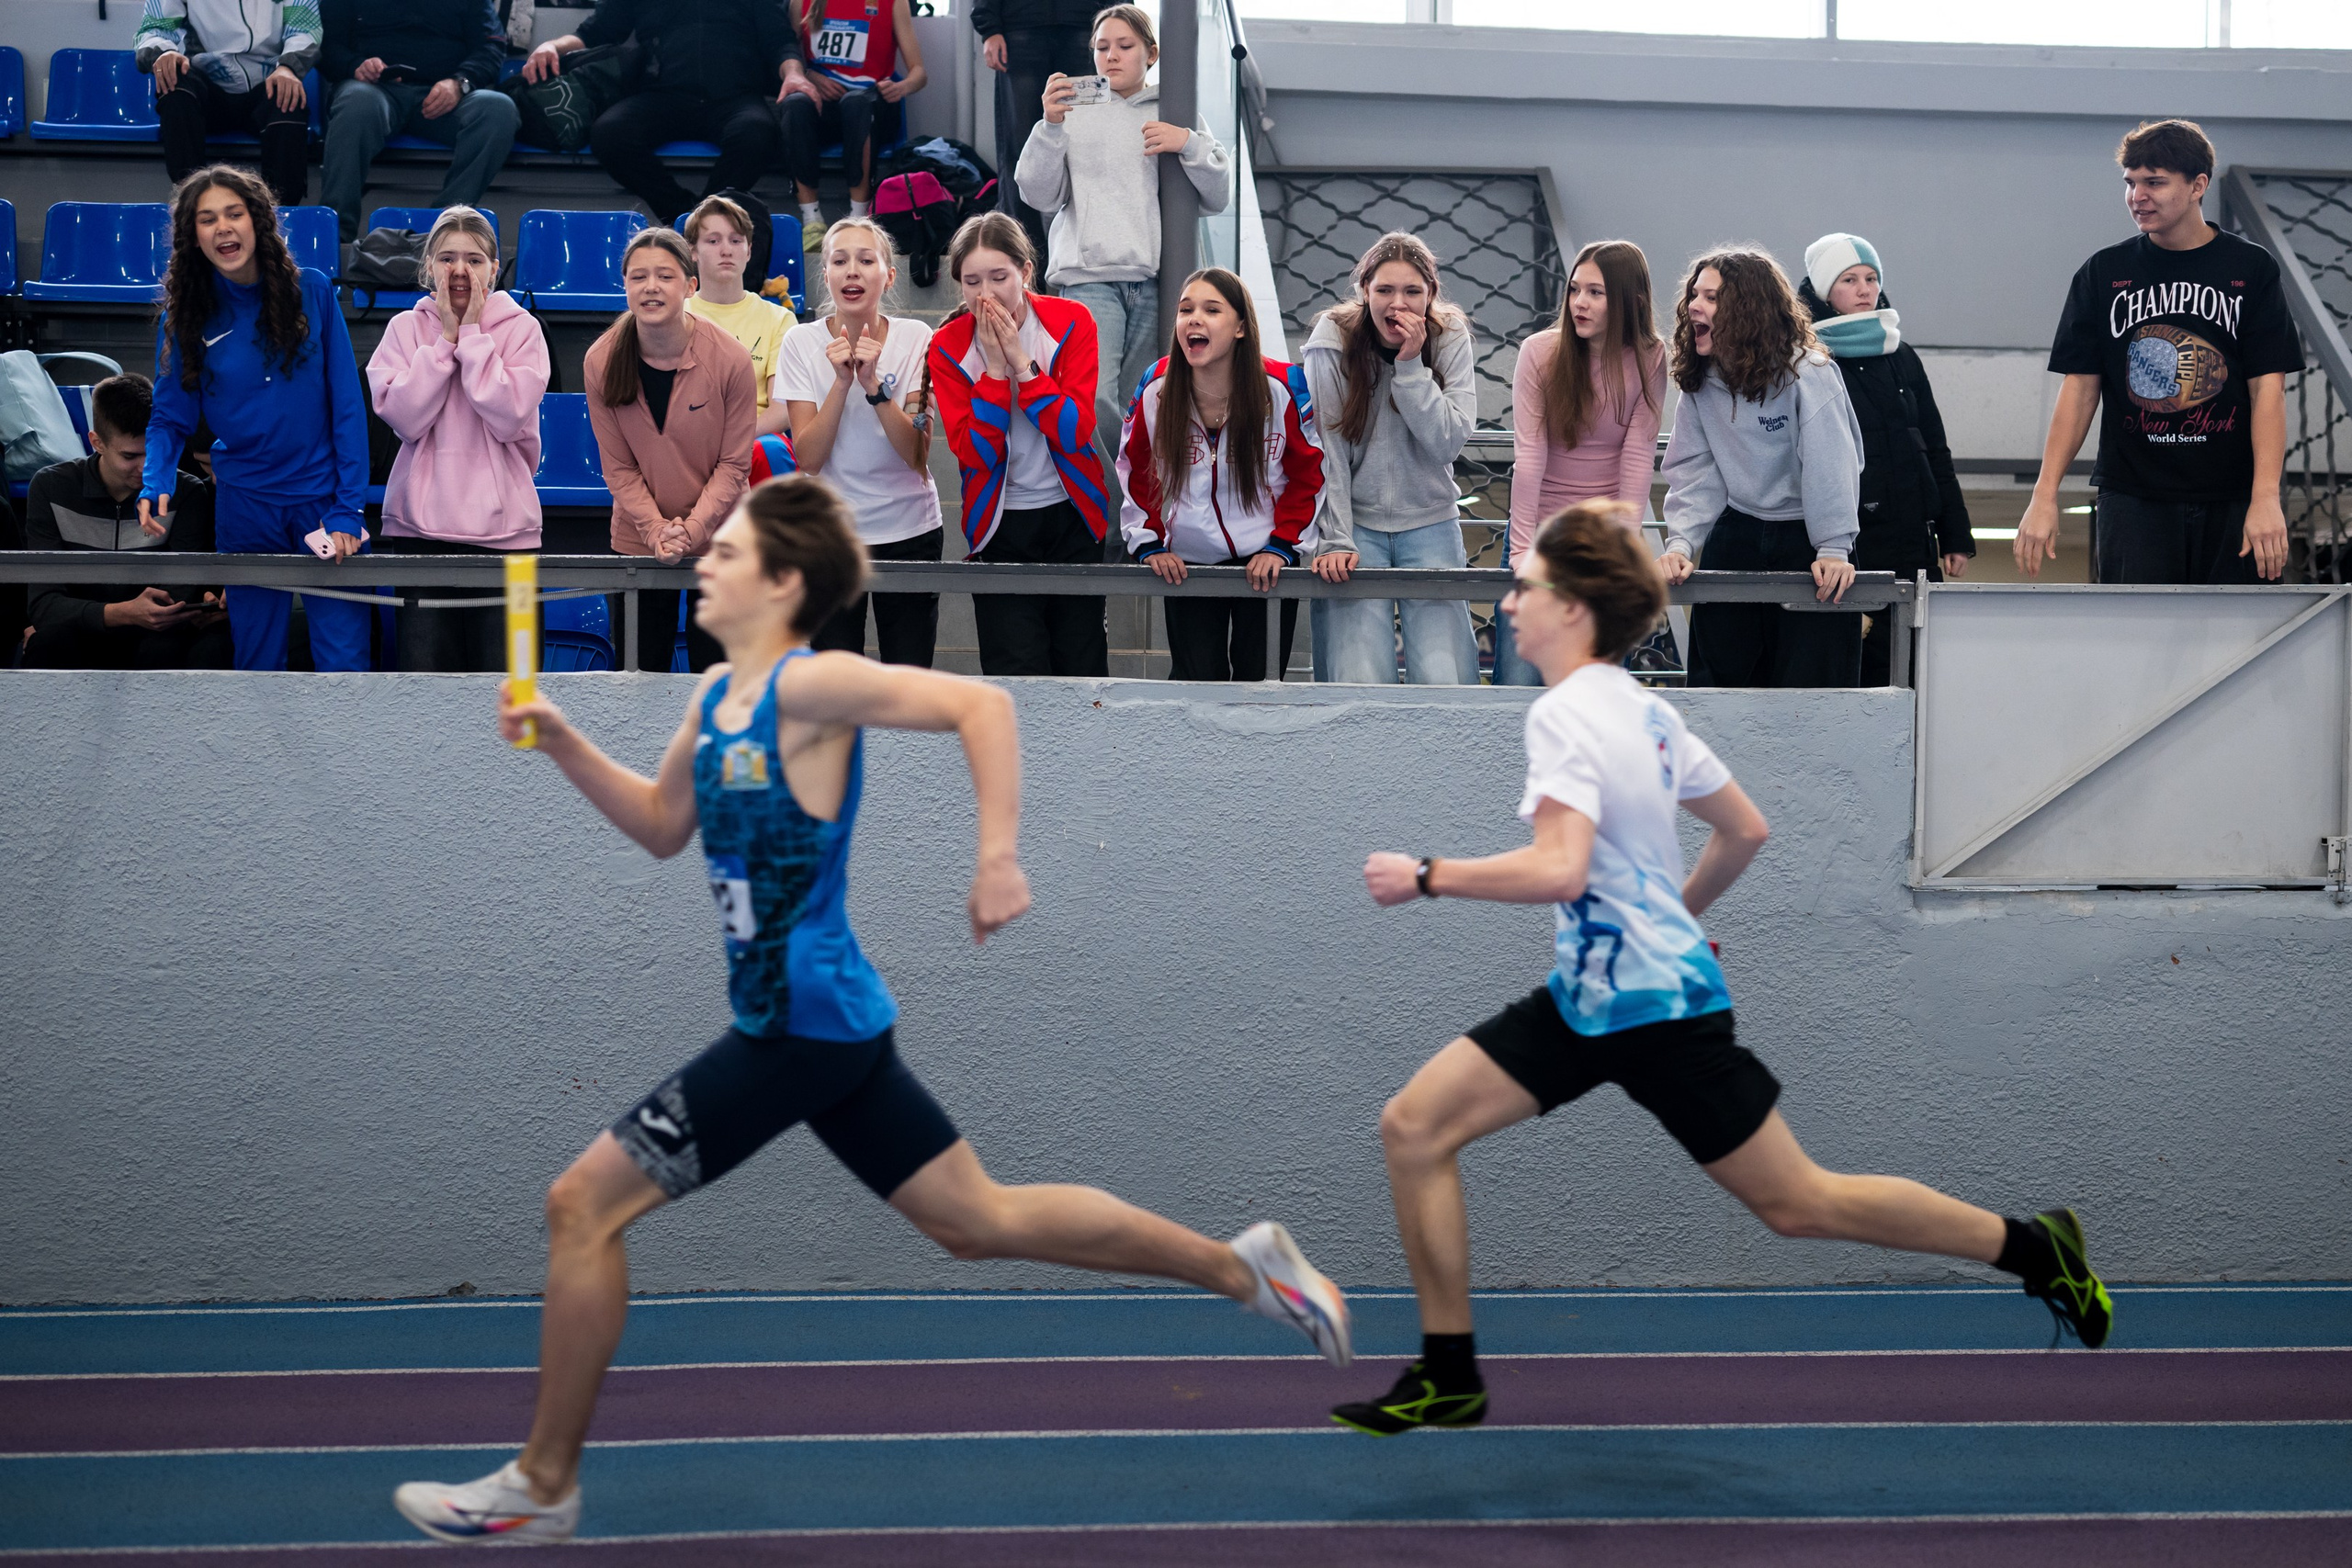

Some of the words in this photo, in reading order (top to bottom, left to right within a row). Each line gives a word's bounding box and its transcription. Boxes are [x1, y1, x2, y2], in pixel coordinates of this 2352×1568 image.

[818, 31, 856, 58] 487
[2112, 280, 2132, 288] DEPT
[2109, 281, 2244, 341] CHAMPIONS
[2128, 343, 2177, 396] RANGERS
[2177, 350, 2195, 380] CUP
[1765, 422, 1785, 433] Club
[2122, 406, 2169, 434] New
[2180, 403, 2235, 435] York
[2147, 434, 2176, 443] World
[2178, 434, 2207, 443] Series
